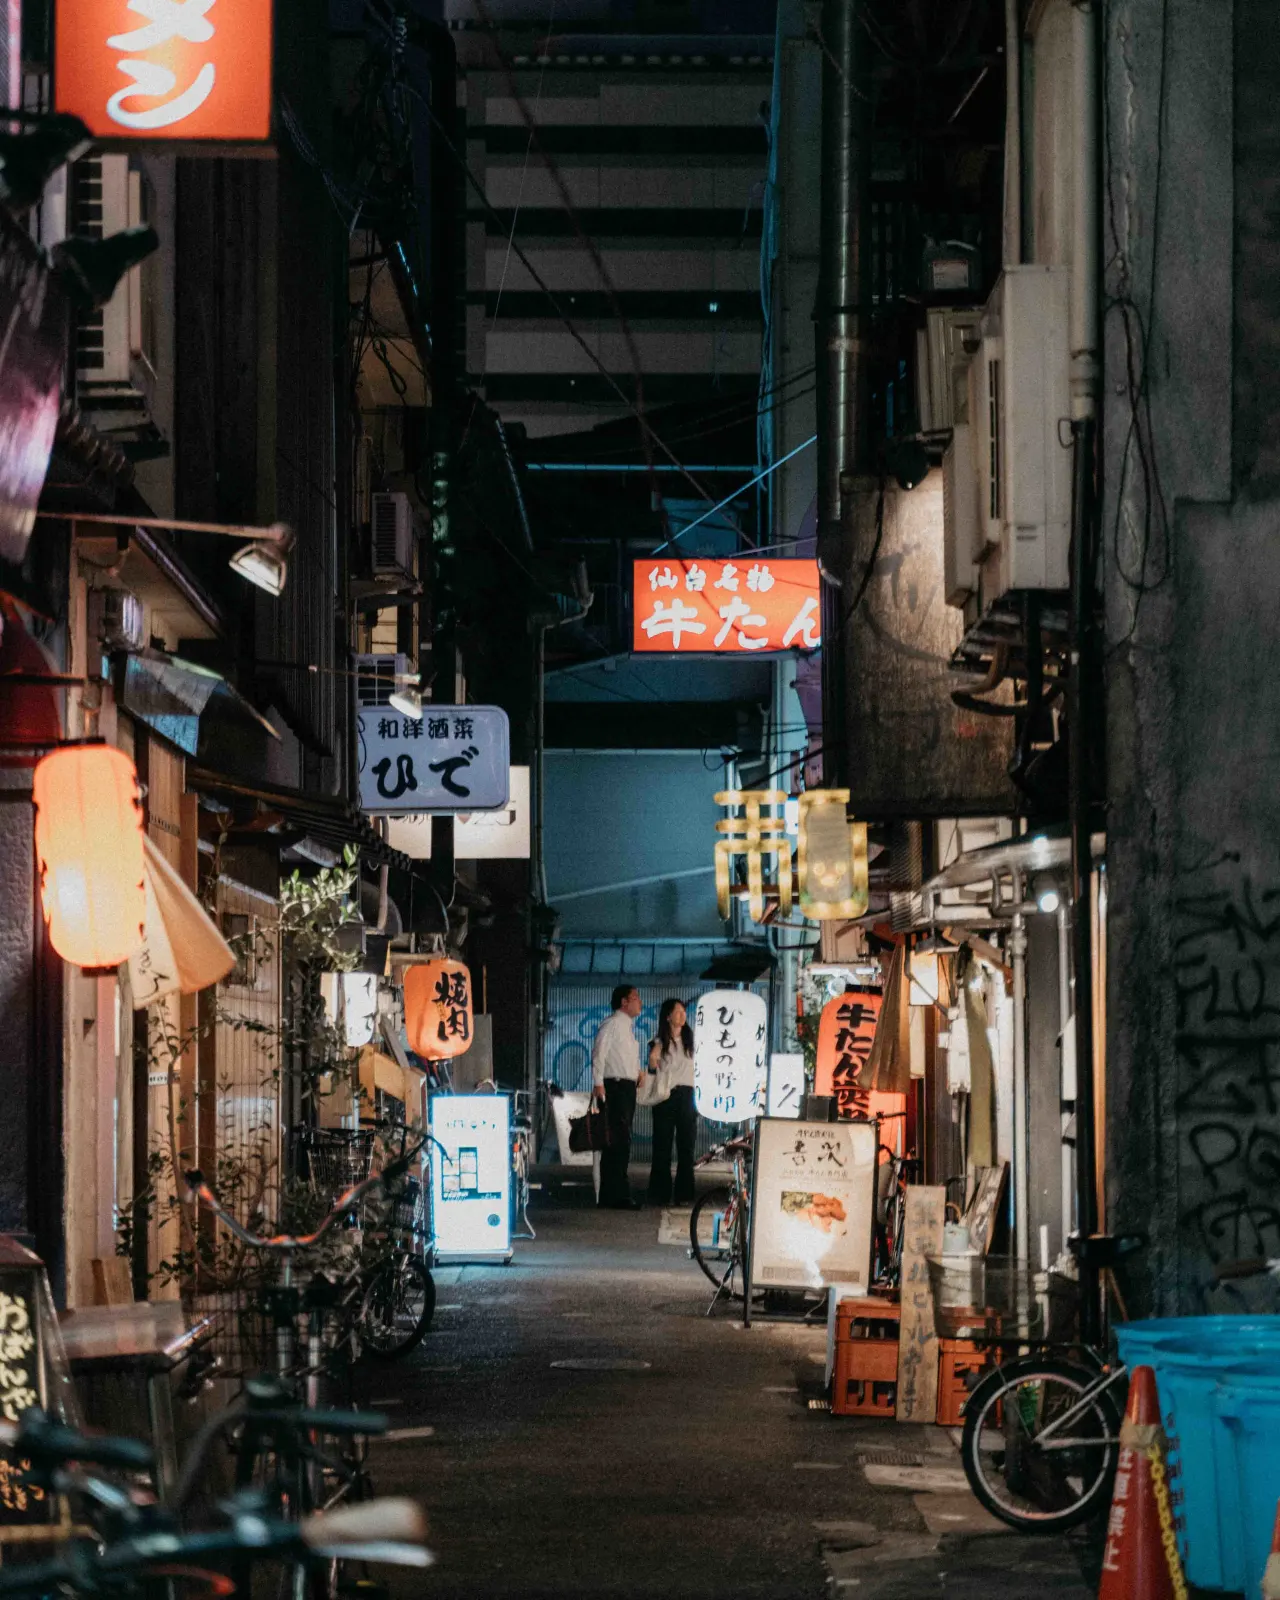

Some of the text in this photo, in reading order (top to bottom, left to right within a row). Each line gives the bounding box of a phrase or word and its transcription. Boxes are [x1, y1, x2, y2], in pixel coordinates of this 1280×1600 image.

[648, 563, 776, 592] 仙台名物
[641, 595, 822, 650] 牛たん
[378, 717, 474, 740] 和洋酒菜
[371, 746, 480, 799] ひで
[432, 971, 470, 1042] 焼肉
